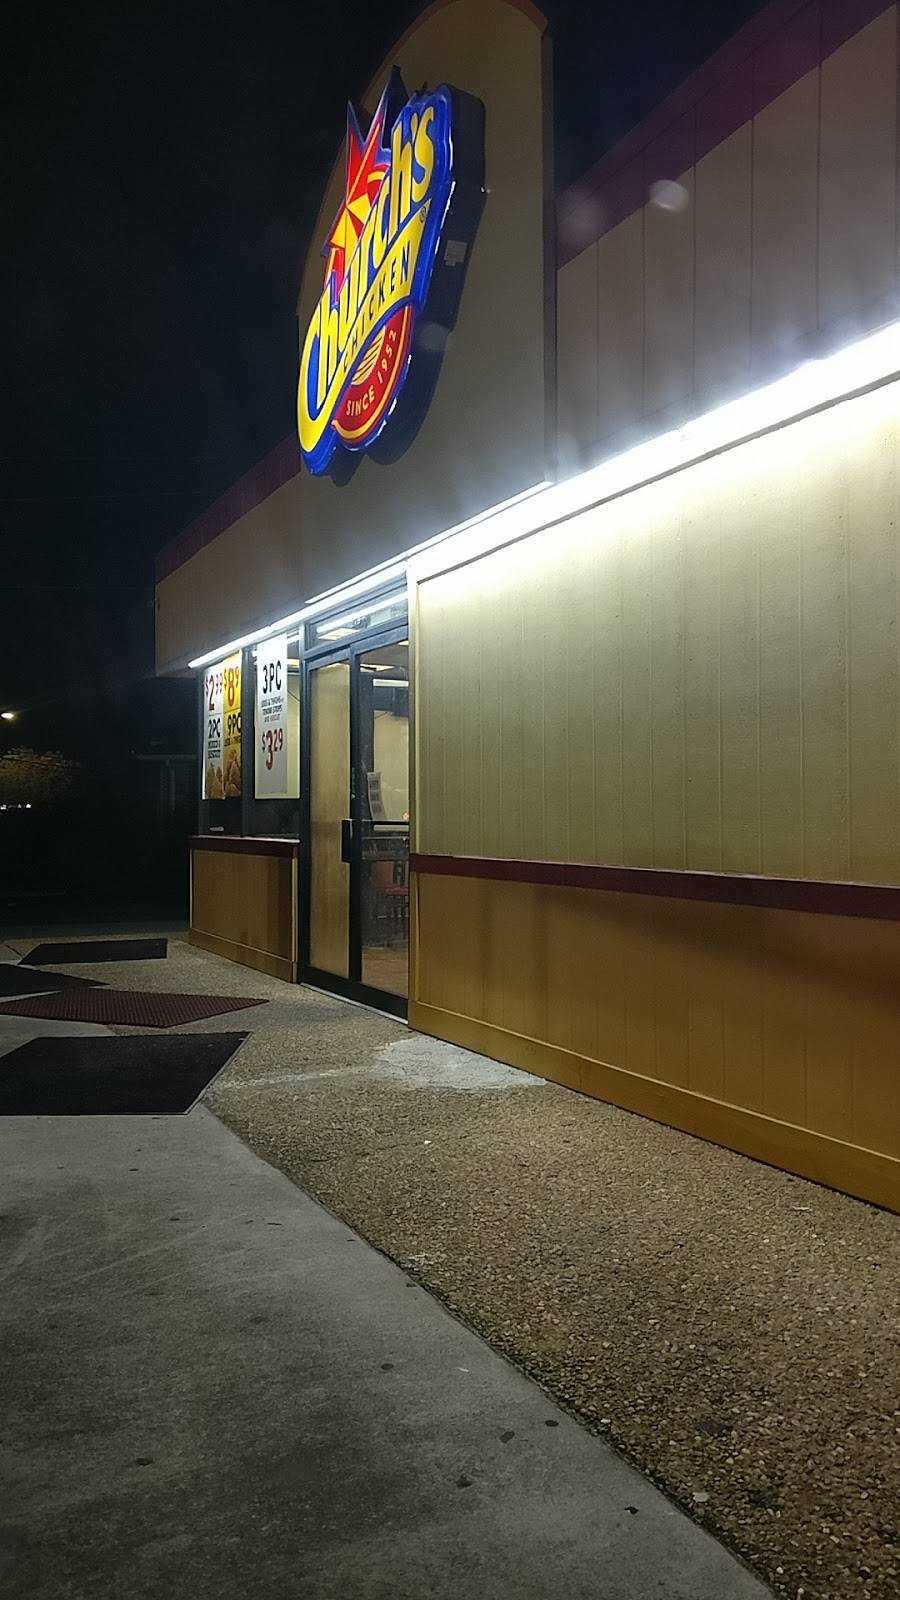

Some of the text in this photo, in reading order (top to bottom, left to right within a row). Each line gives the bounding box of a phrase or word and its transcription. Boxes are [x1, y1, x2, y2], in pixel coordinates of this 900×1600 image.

[297, 106, 436, 453] Church's
[343, 252, 411, 370] CHICKEN
[345, 329, 397, 417] SINCE 1952
[262, 660, 282, 694] 3PC
[207, 718, 221, 739] 2PC
